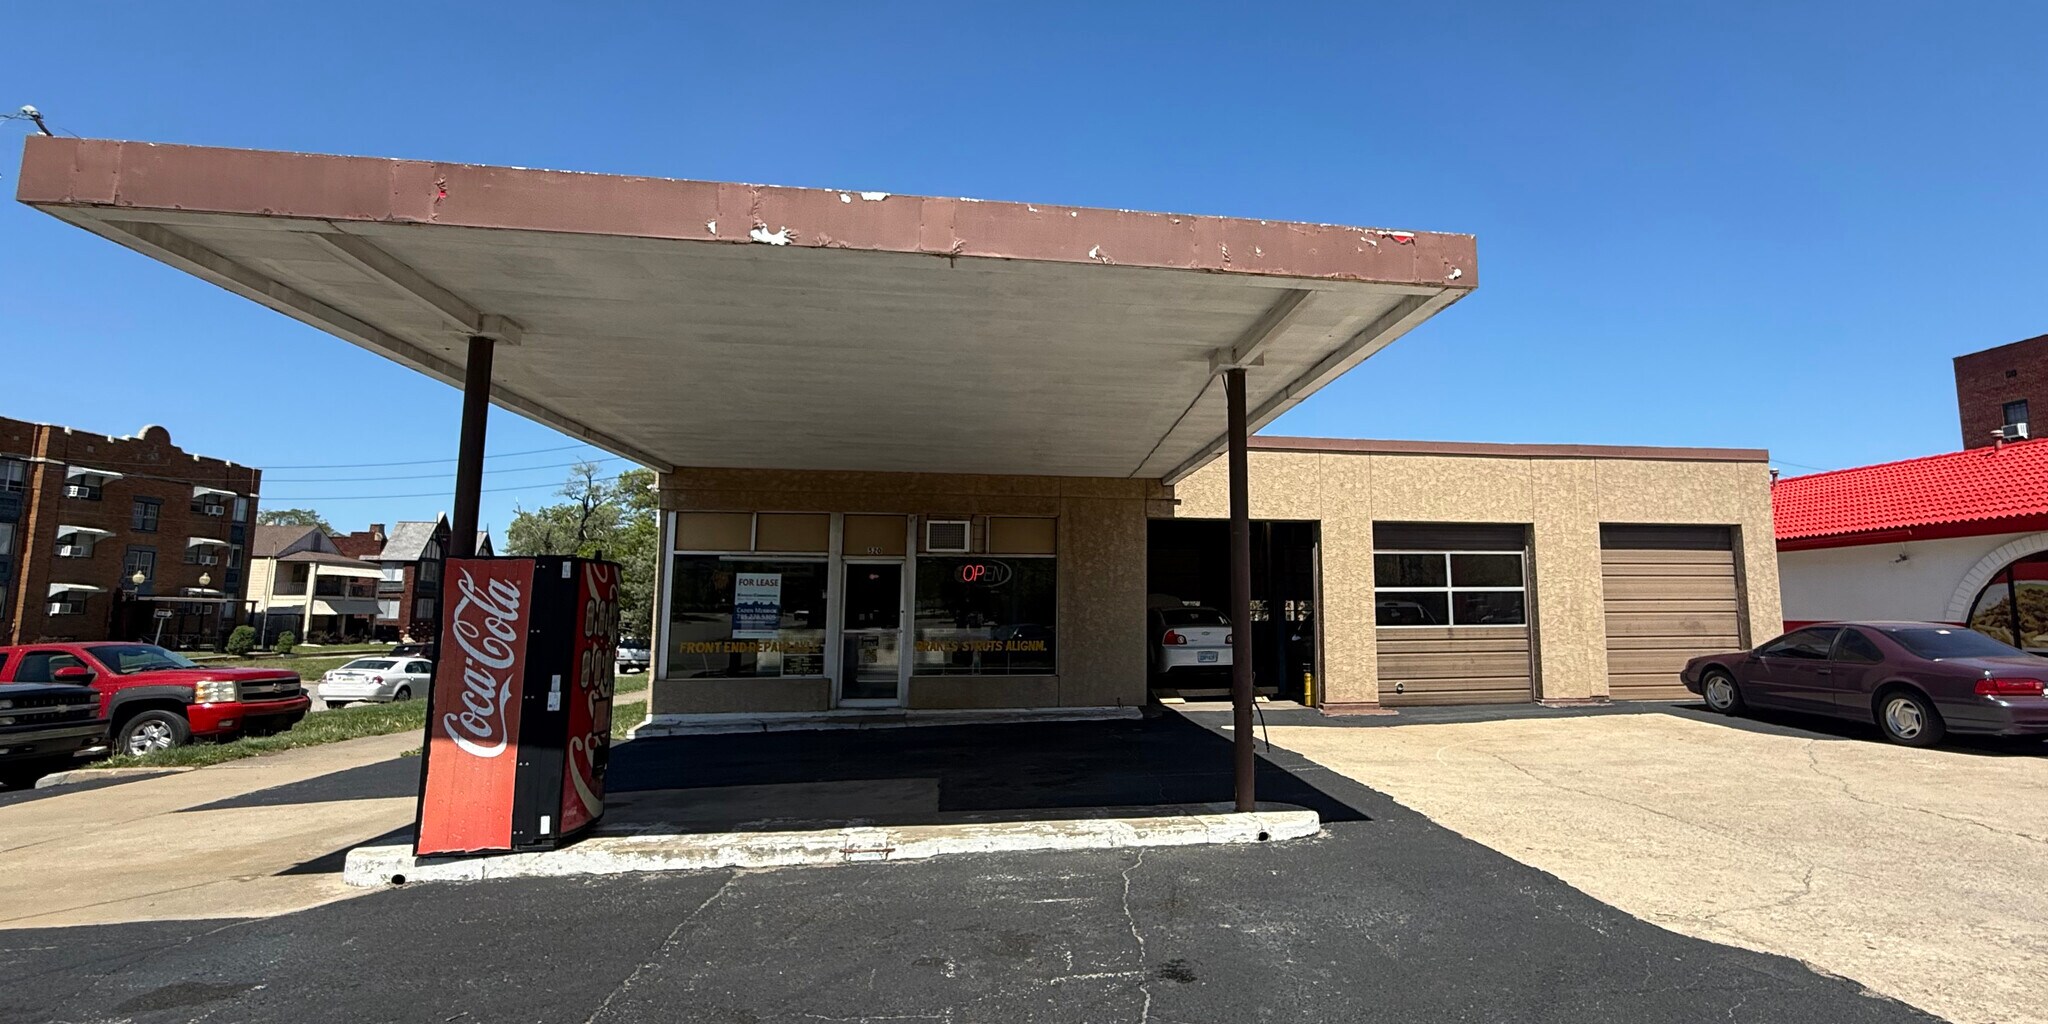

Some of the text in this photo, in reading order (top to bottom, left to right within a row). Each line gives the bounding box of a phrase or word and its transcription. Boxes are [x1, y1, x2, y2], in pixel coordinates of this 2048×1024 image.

[962, 564, 1004, 582] OPEN
[738, 578, 779, 587] FOR LEASE
[679, 641, 722, 654] FRONT
[962, 640, 1004, 652] STRUTS
[443, 566, 521, 758] Coca-Cola
